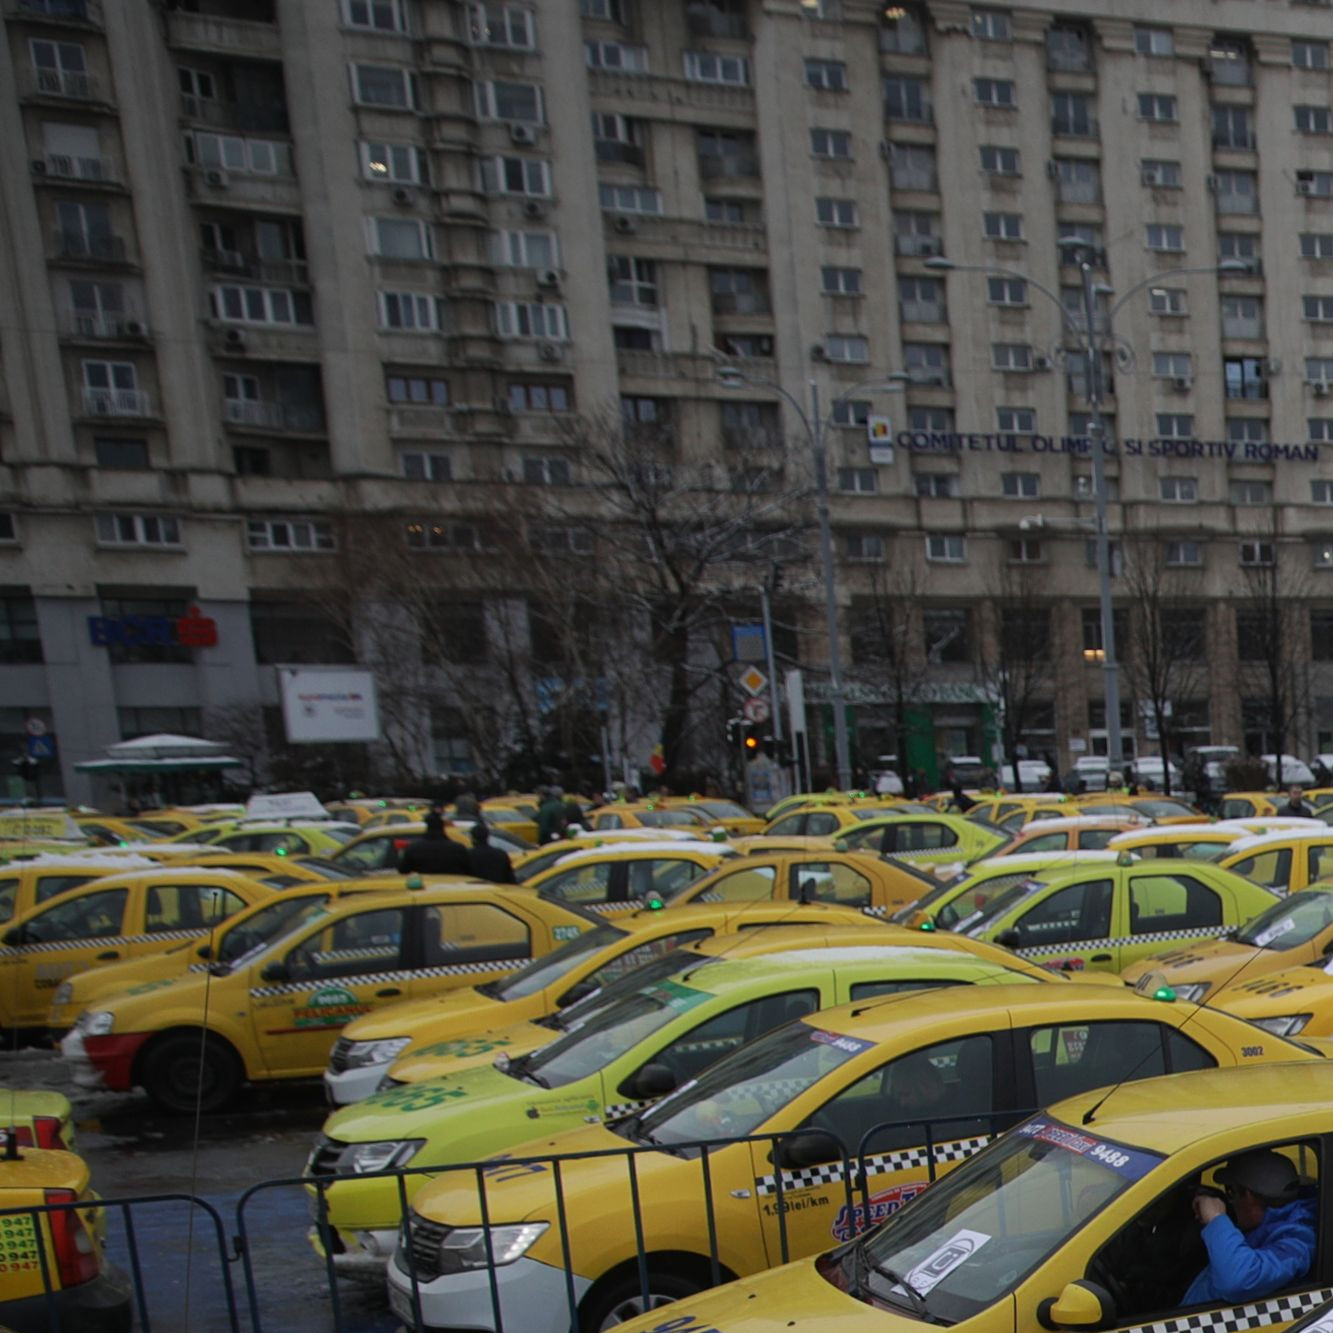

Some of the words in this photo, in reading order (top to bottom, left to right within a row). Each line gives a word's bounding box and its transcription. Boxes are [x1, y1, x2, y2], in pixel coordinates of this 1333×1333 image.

[897, 431, 1023, 453] COMITETUL
[1149, 440, 1236, 459] SPORTIV
[1241, 1045, 1264, 1057] 3002
[1090, 1144, 1130, 1167] 9488
